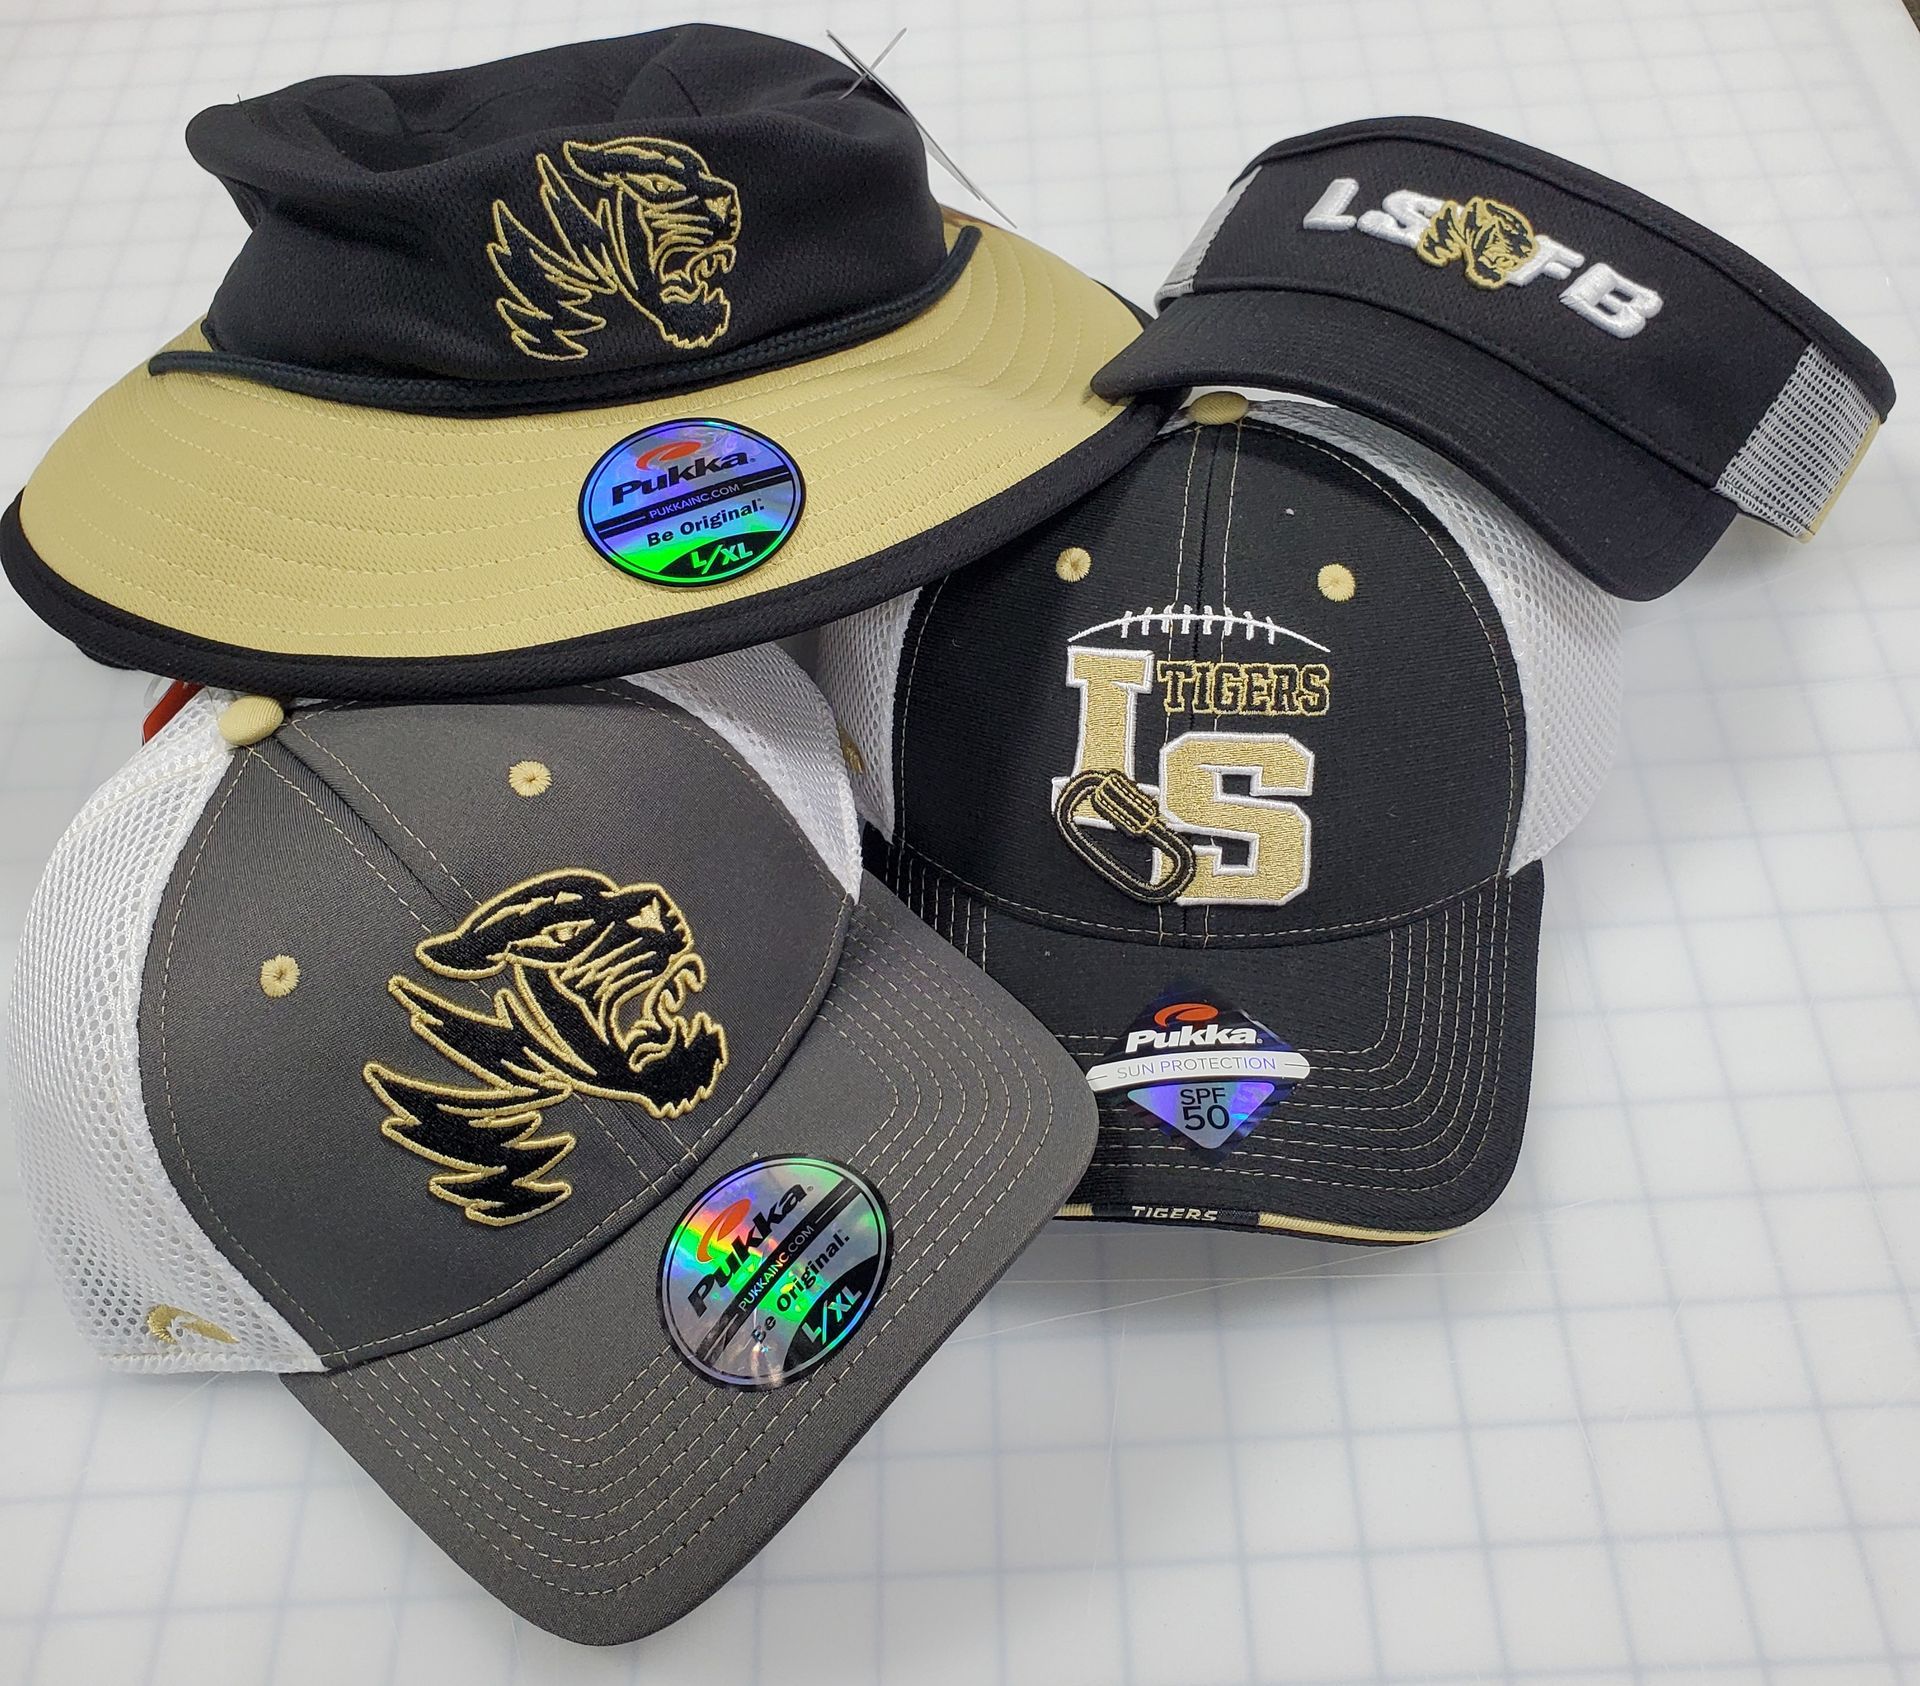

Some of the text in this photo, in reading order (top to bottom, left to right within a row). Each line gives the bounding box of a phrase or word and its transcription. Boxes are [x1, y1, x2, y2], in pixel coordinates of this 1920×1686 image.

[611, 451, 748, 506] Pukka
[649, 483, 740, 519] PUKKAINC.COM
[646, 530, 674, 547] Be
[690, 542, 753, 575] L/XL
[1156, 659, 1331, 716] TIGERS
[1125, 1024, 1263, 1053] Pukka
[1117, 1057, 1276, 1079] SUN PROTECTION
[1180, 1087, 1226, 1105] SPF
[1182, 1104, 1231, 1131] 50
[1131, 1205, 1219, 1222] TIGERS
[687, 1183, 808, 1319] Pukka
[738, 1224, 816, 1313] PUKKAINC.COM
[752, 1315, 777, 1343] Be
[802, 1285, 862, 1345] L/XL
